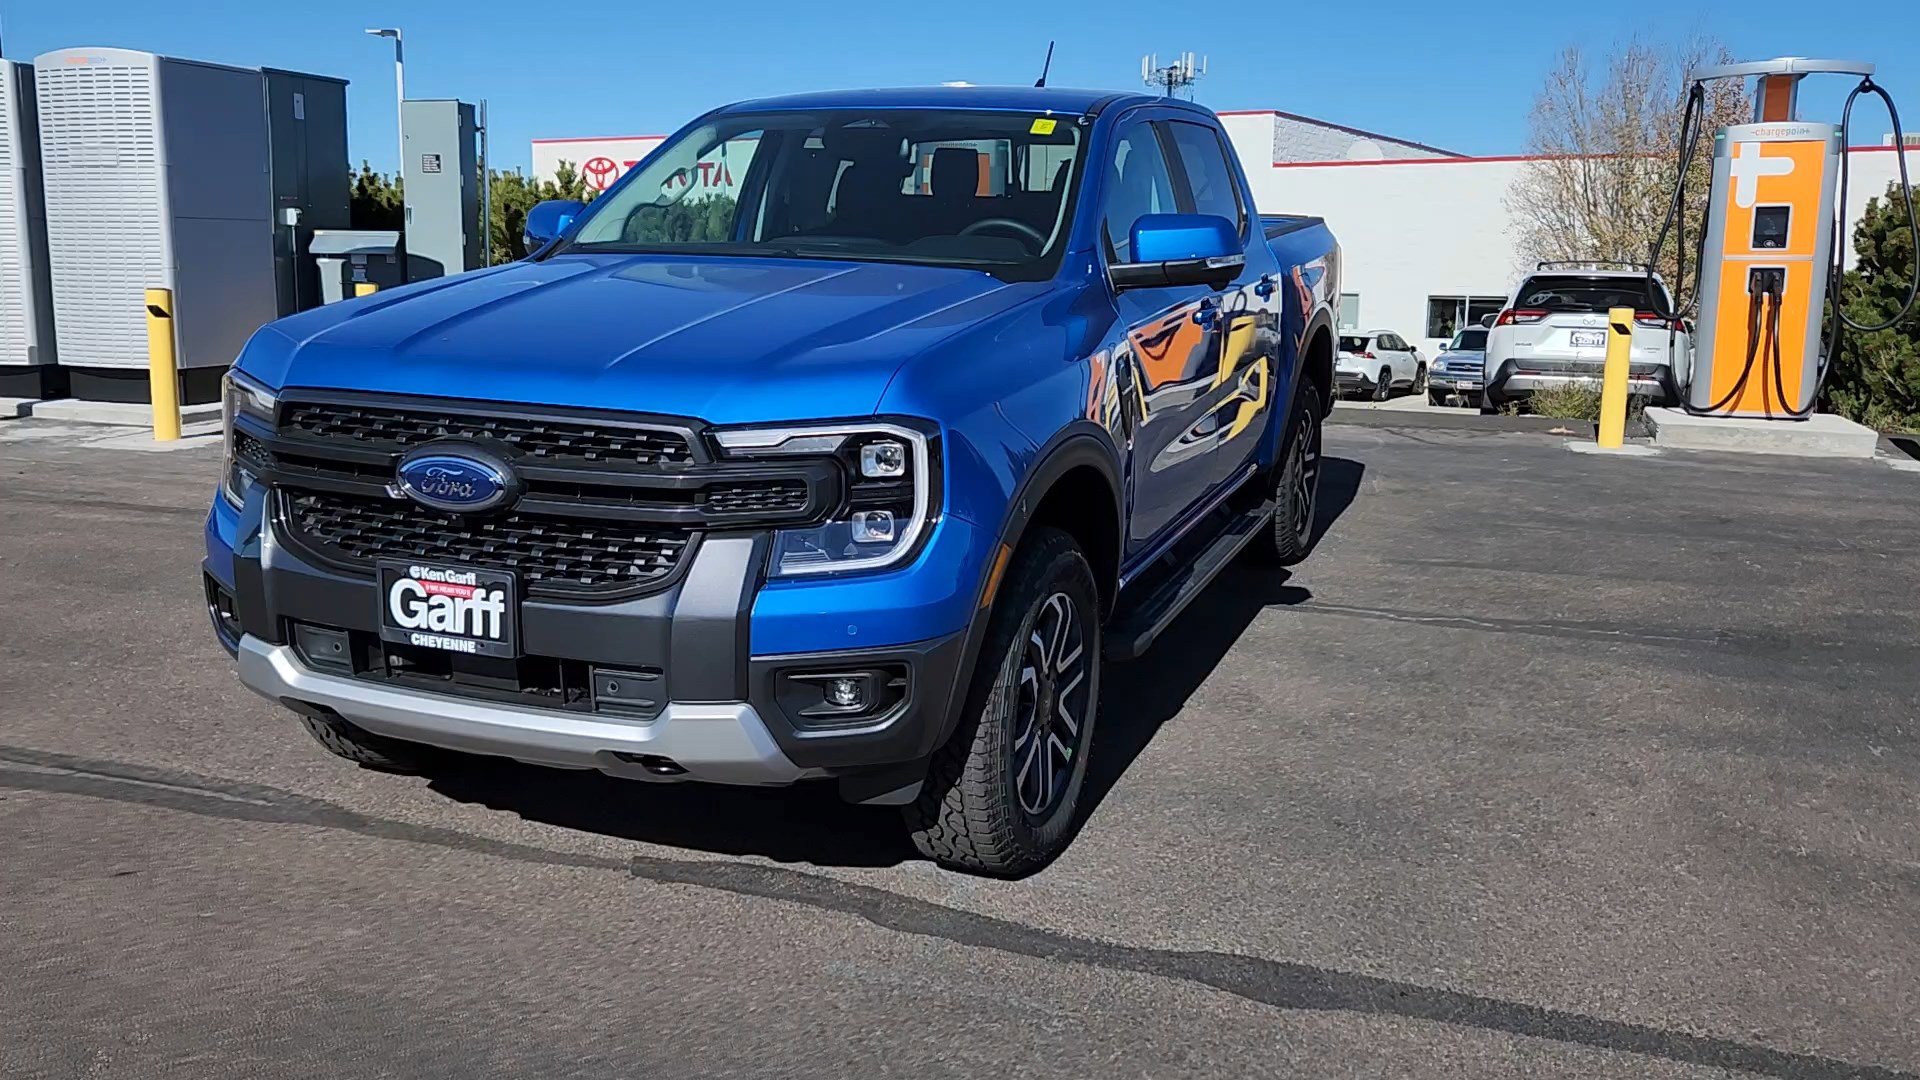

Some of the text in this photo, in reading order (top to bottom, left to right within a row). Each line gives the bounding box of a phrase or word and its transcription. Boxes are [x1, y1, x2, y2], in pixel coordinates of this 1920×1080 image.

[421, 467, 477, 497] Ford
[420, 566, 476, 585] Ken Garff
[389, 578, 505, 639] Garff
[410, 633, 476, 653] CHEYENNE
